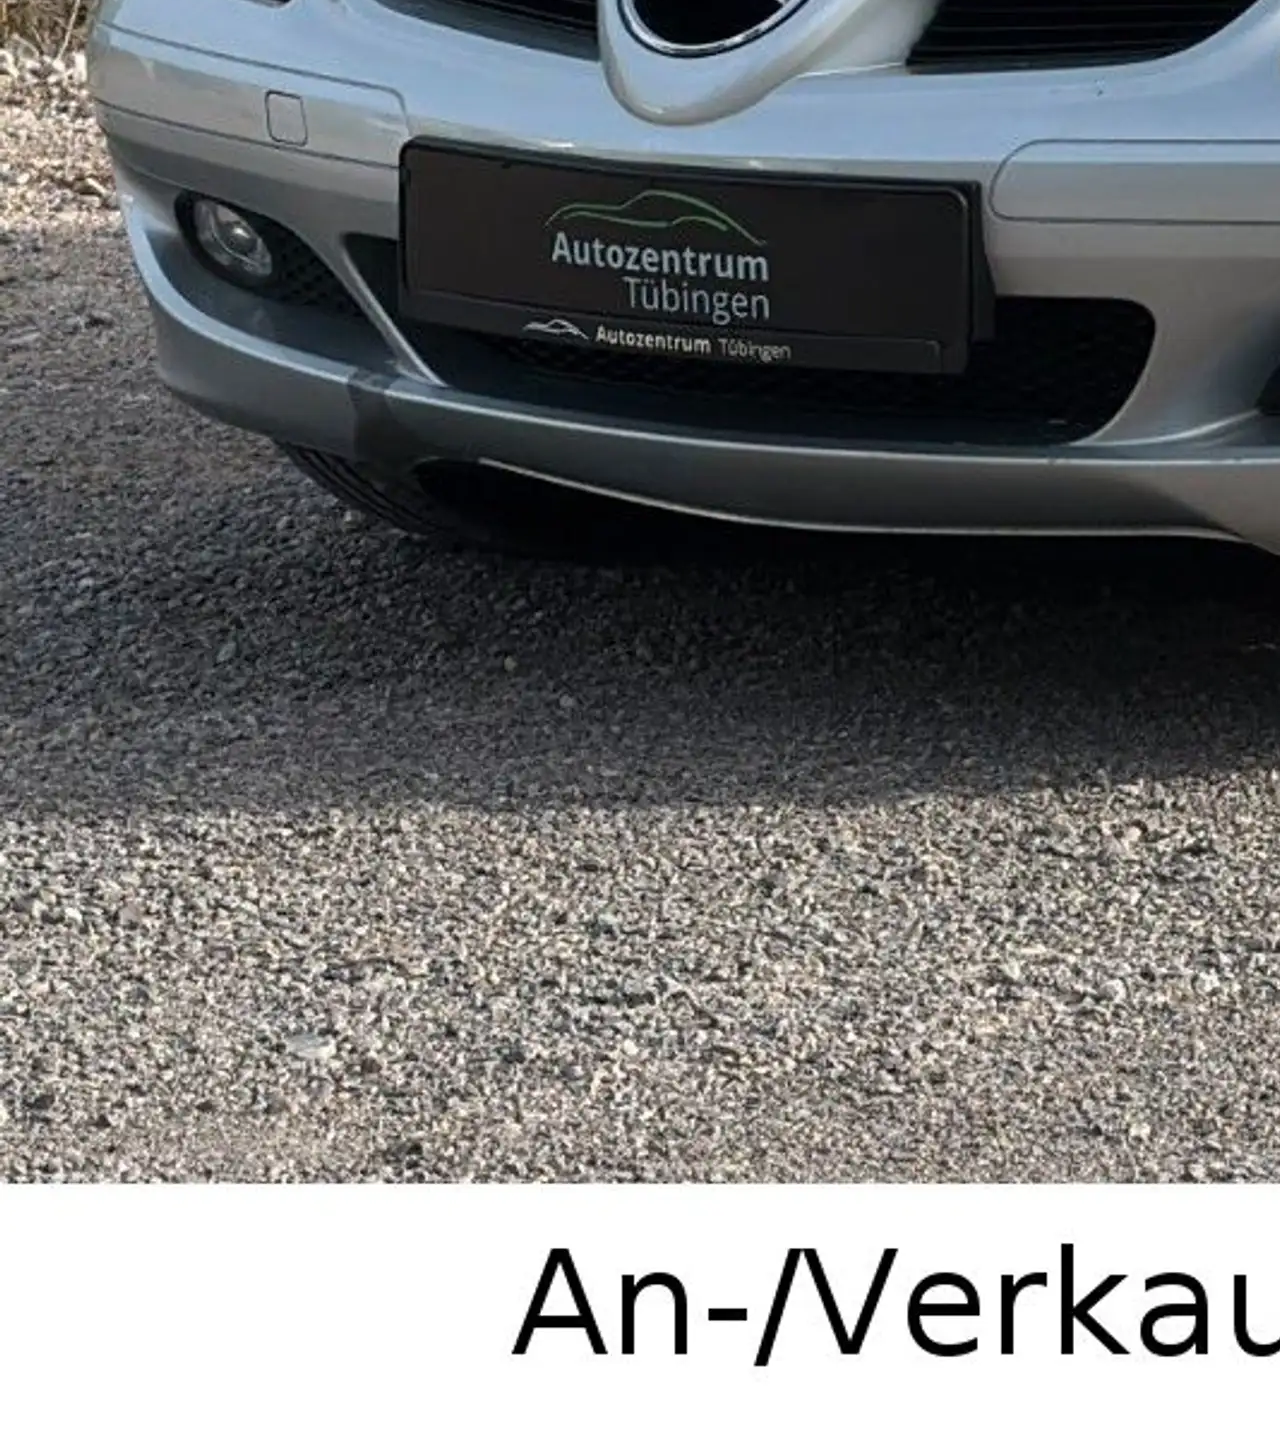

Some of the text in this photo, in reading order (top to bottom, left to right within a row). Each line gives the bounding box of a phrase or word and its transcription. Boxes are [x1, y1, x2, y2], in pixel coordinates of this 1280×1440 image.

[551, 230, 770, 282] Autozentrum
[622, 274, 771, 325] Tübingen
[595, 324, 793, 362] Autozentrum Tübingen
